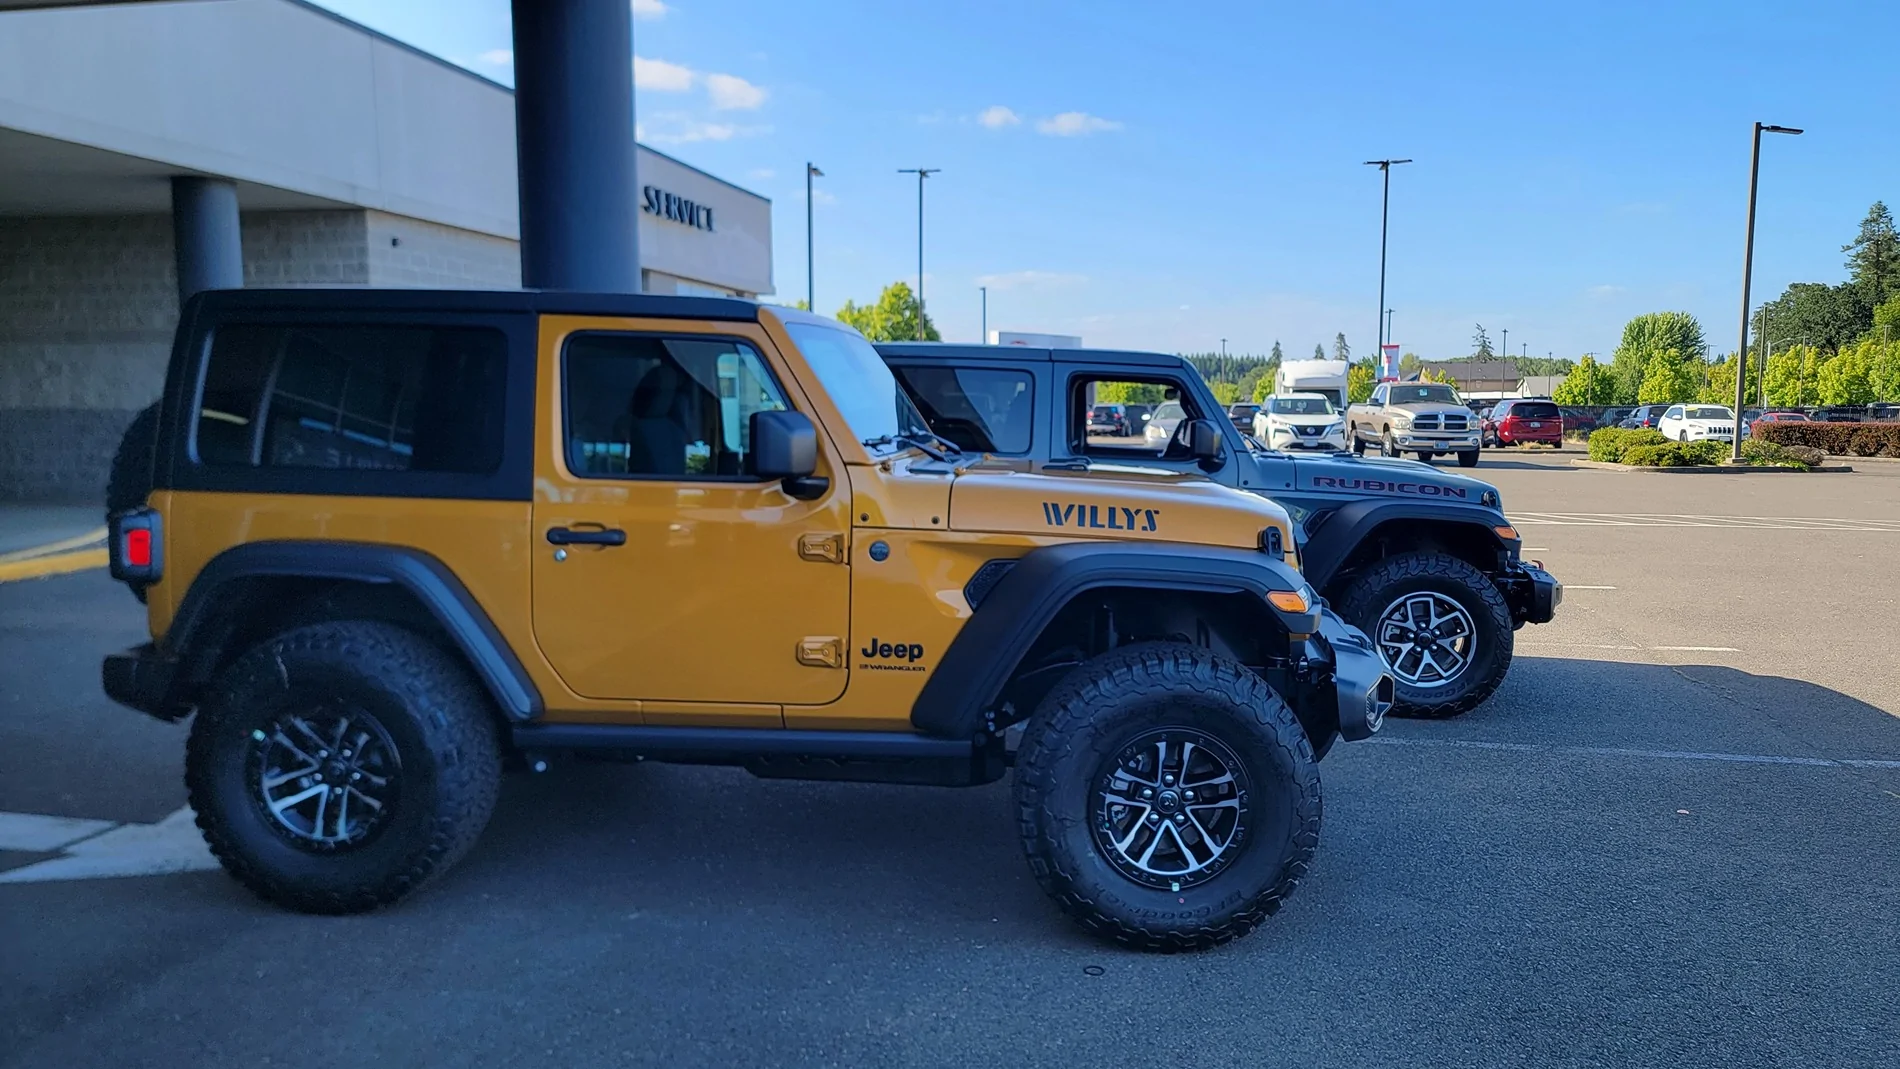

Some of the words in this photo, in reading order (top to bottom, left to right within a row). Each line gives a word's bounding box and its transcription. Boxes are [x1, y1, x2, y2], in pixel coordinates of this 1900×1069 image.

[642, 185, 714, 231] SERVICE
[1313, 476, 1466, 498] RUBICON
[1042, 502, 1160, 532] WILLYS
[861, 637, 924, 663] Jeep
[869, 664, 926, 672] WRANGLER
